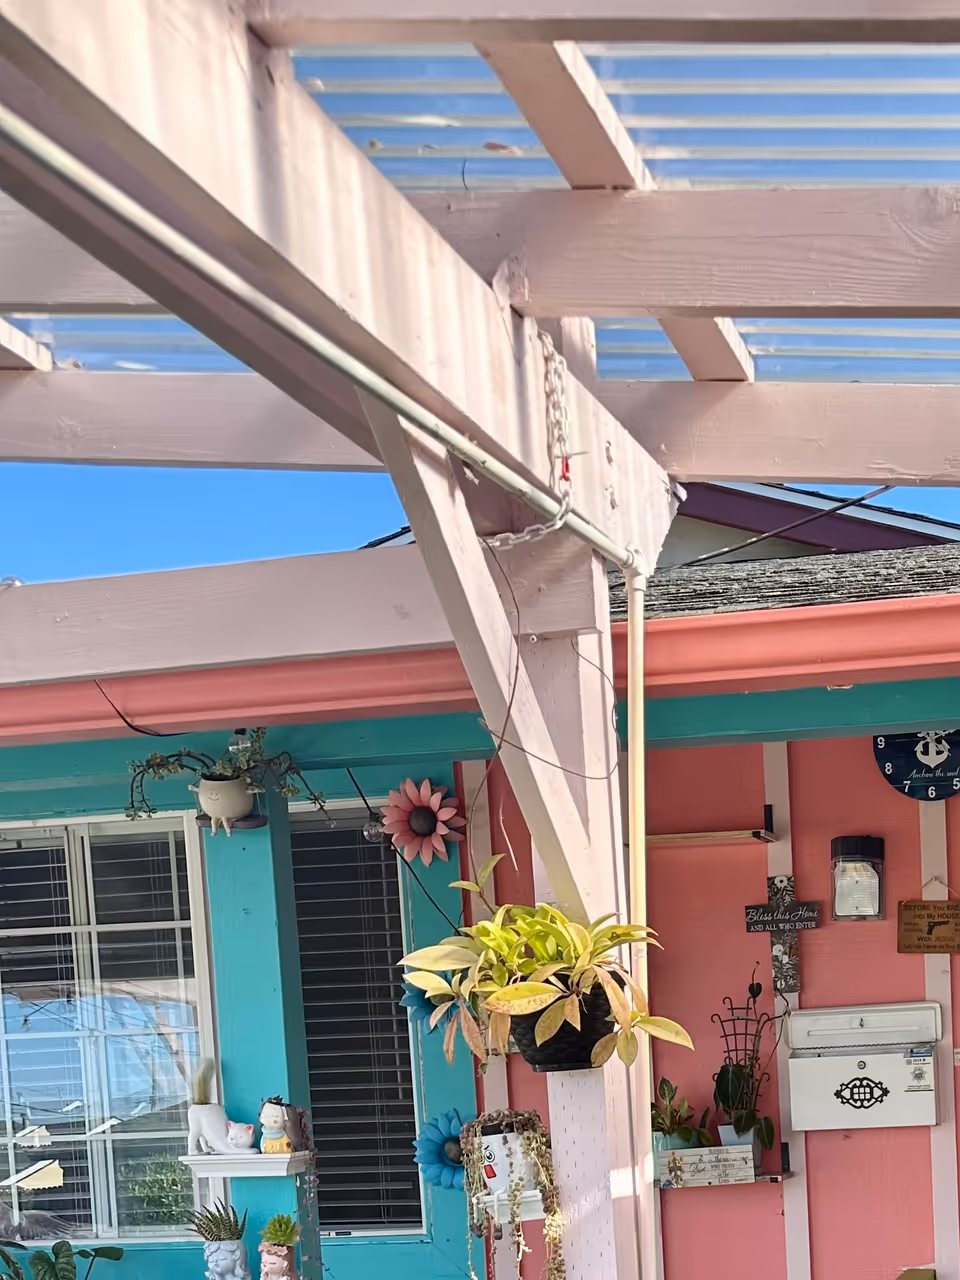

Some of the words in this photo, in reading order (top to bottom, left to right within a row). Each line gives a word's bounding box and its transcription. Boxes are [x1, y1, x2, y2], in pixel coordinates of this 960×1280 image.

[877, 736, 885, 749] 9
[884, 762, 893, 774] 8
[935, 767, 944, 777] the
[903, 780, 911, 792] 7
[952, 778, 960, 790] 5
[928, 786, 936, 798] 6
[746, 908, 772, 922] Bless
[773, 906, 790, 920] this
[790, 906, 819, 920] Home
[765, 923, 777, 931] ALL
[779, 922, 794, 930] WHO
[795, 921, 816, 929] ENTER
